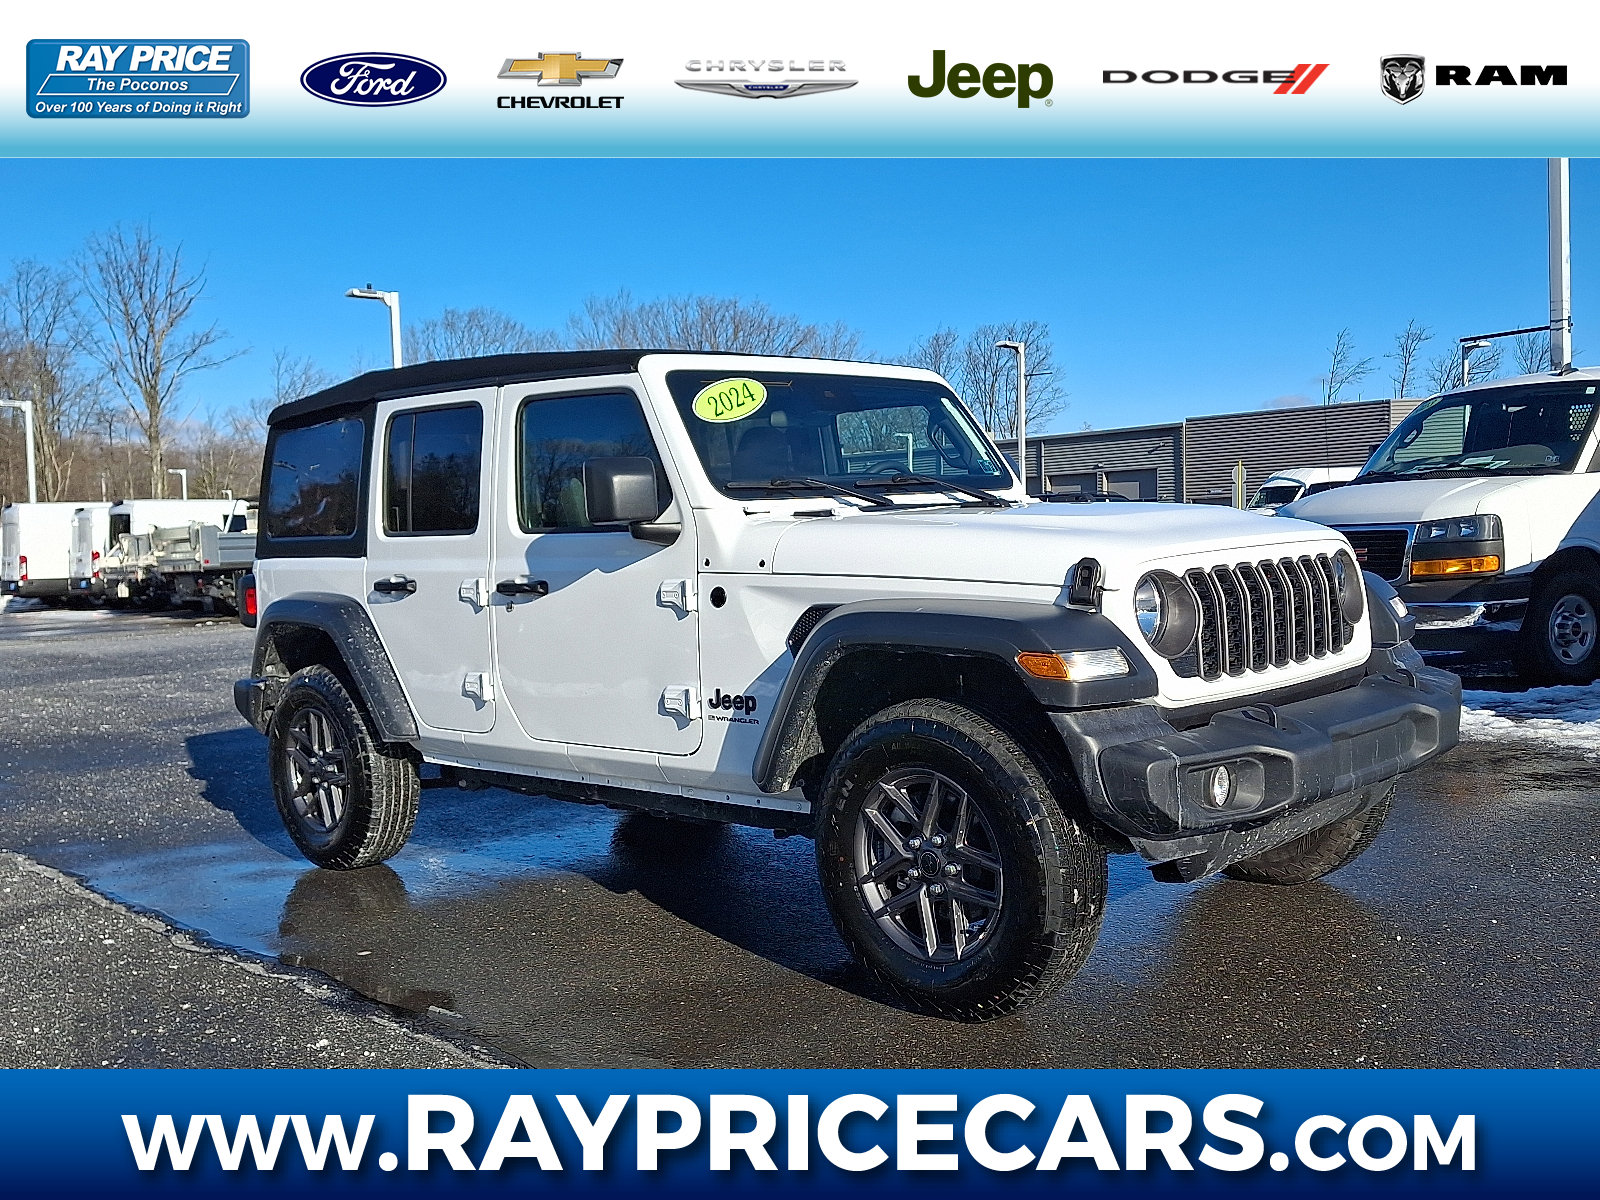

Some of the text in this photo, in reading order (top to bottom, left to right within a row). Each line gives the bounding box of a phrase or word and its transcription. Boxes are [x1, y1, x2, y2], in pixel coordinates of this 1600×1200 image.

[707, 382, 756, 417] 2024
[708, 688, 757, 715] Jeep
[715, 715, 760, 725] WRANGLER
